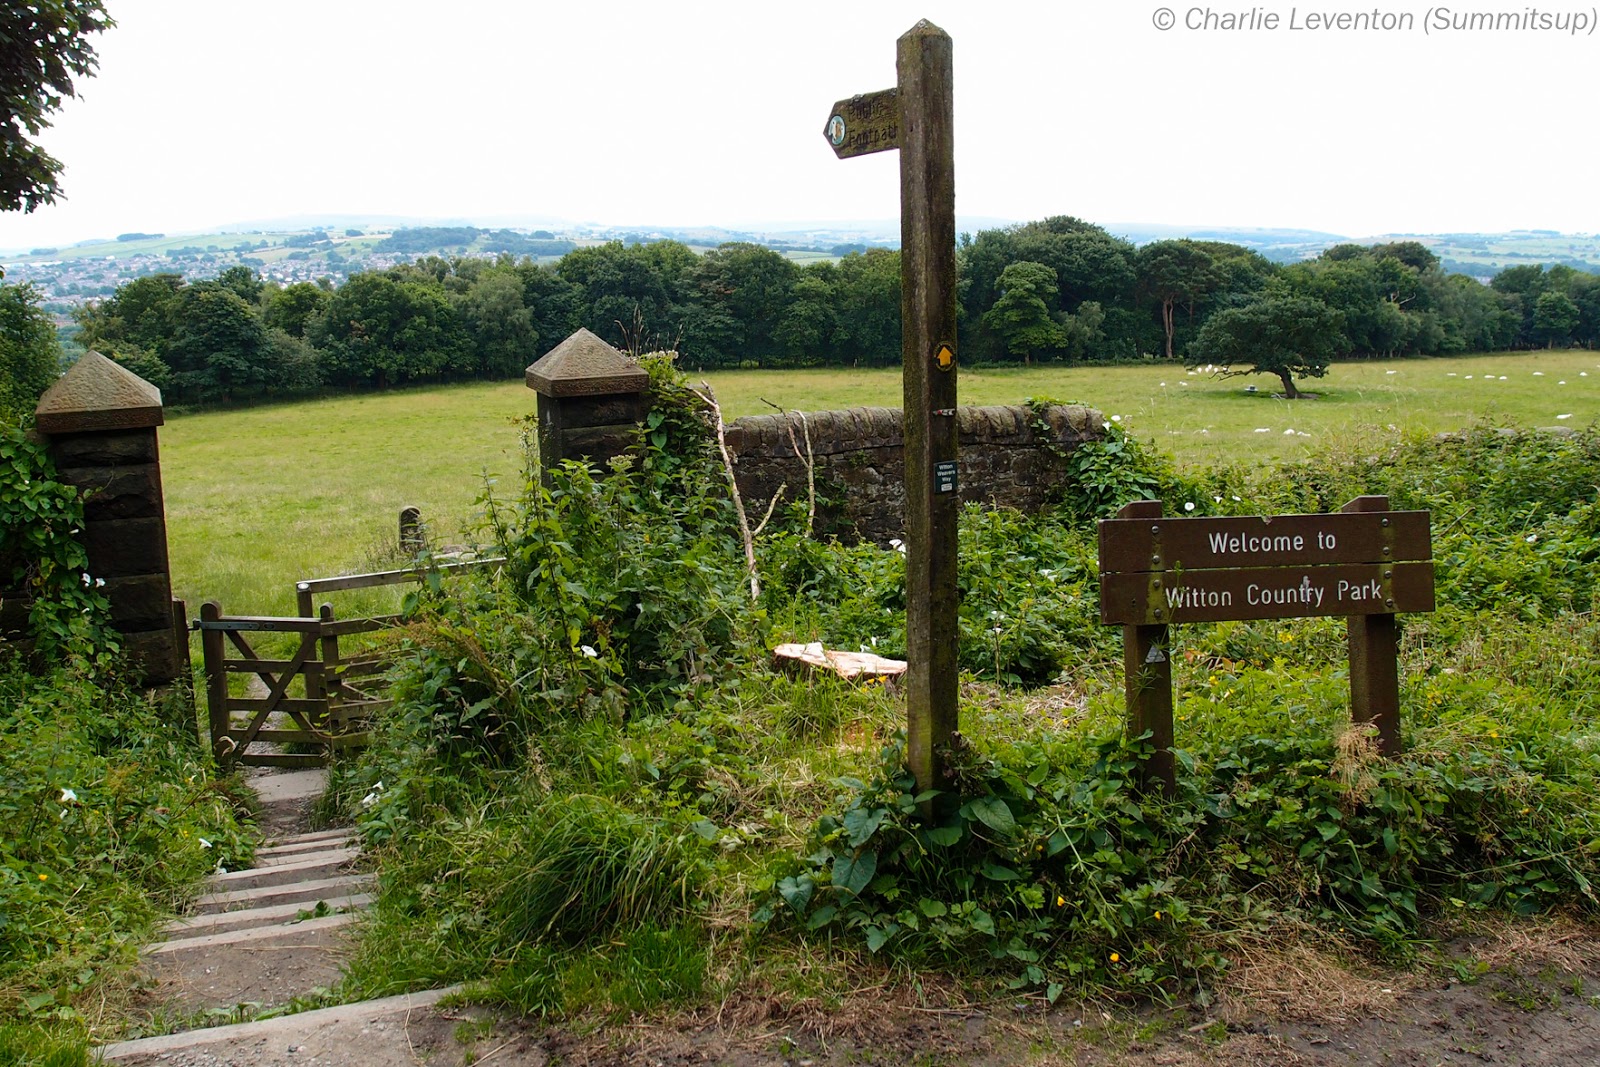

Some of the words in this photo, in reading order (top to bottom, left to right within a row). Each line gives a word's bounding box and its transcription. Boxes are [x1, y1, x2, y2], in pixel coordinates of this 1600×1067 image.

[848, 122, 898, 148] Footpath
[1208, 532, 1304, 554] Welcome
[1317, 531, 1336, 550] to
[1165, 586, 1232, 609] Witton
[1247, 582, 1325, 608] Country
[1337, 579, 1382, 601] Park
